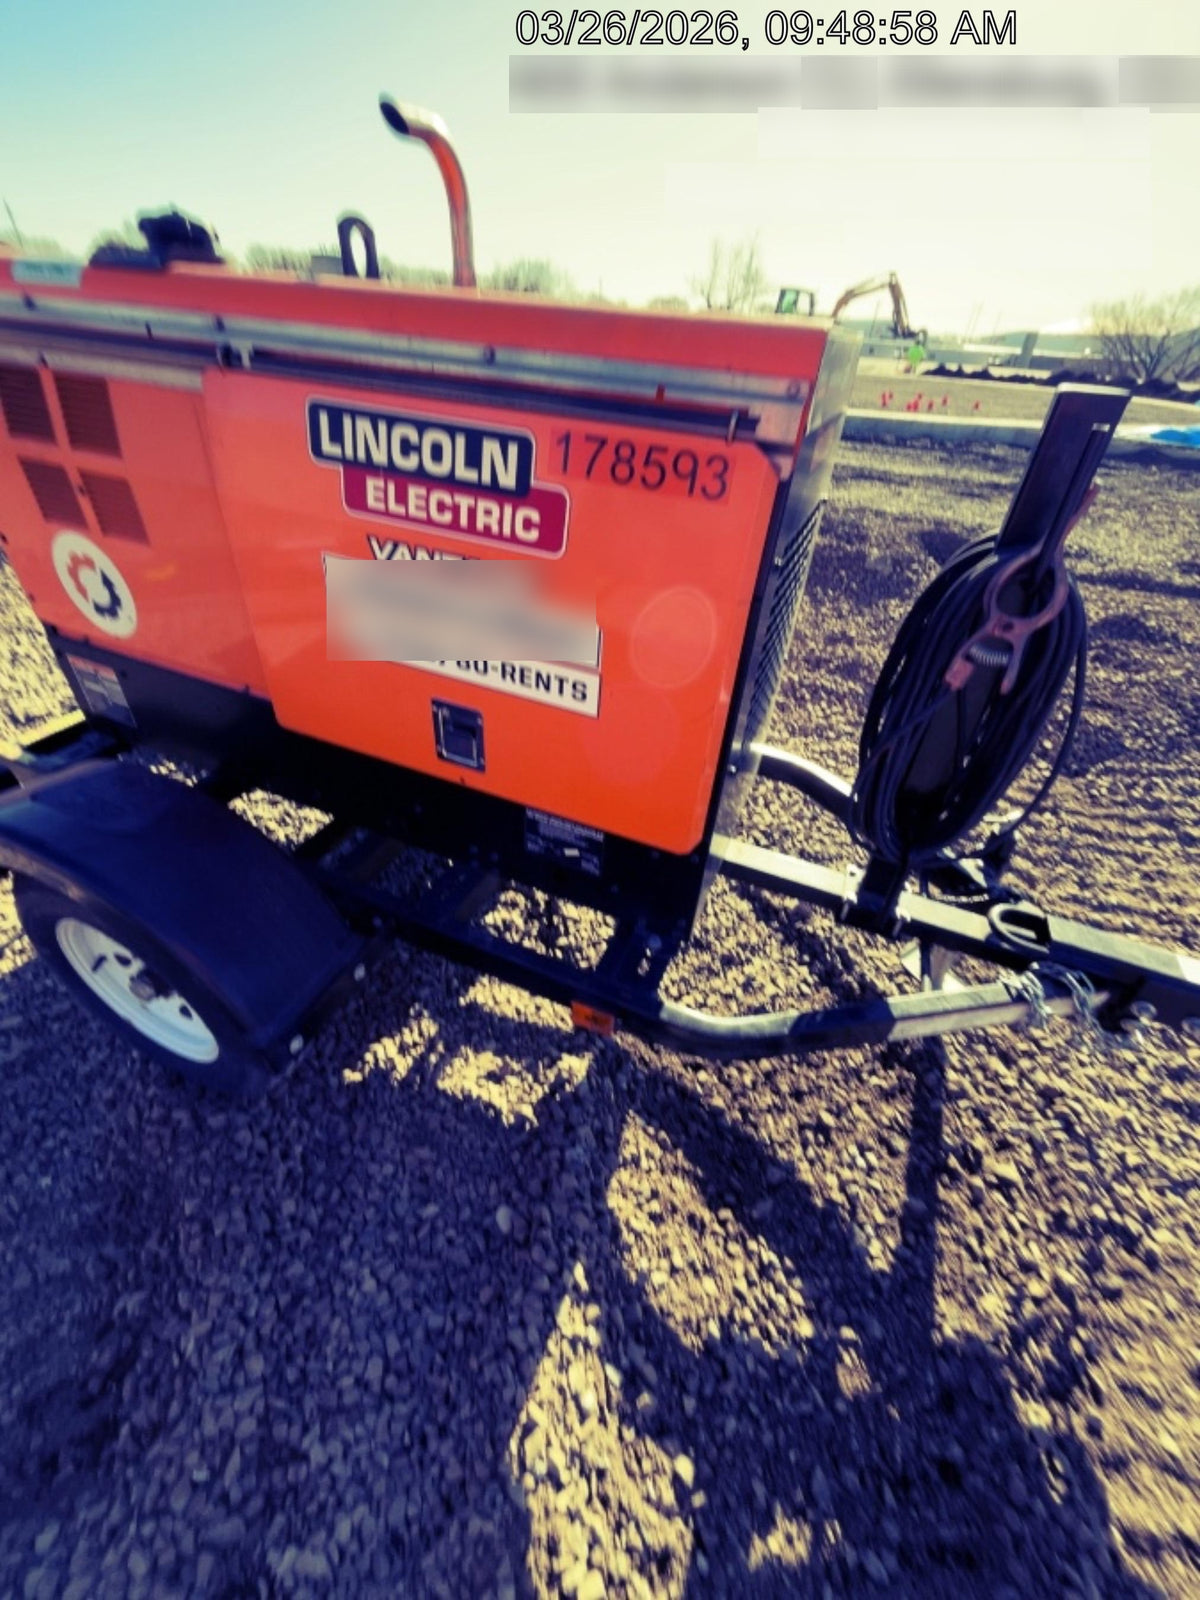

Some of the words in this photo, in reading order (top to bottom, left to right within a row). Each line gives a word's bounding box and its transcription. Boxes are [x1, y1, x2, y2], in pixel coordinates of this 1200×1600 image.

[318, 408, 519, 492] LINCOLN
[557, 430, 729, 502] 178593
[365, 475, 541, 543] ELECTRIC
